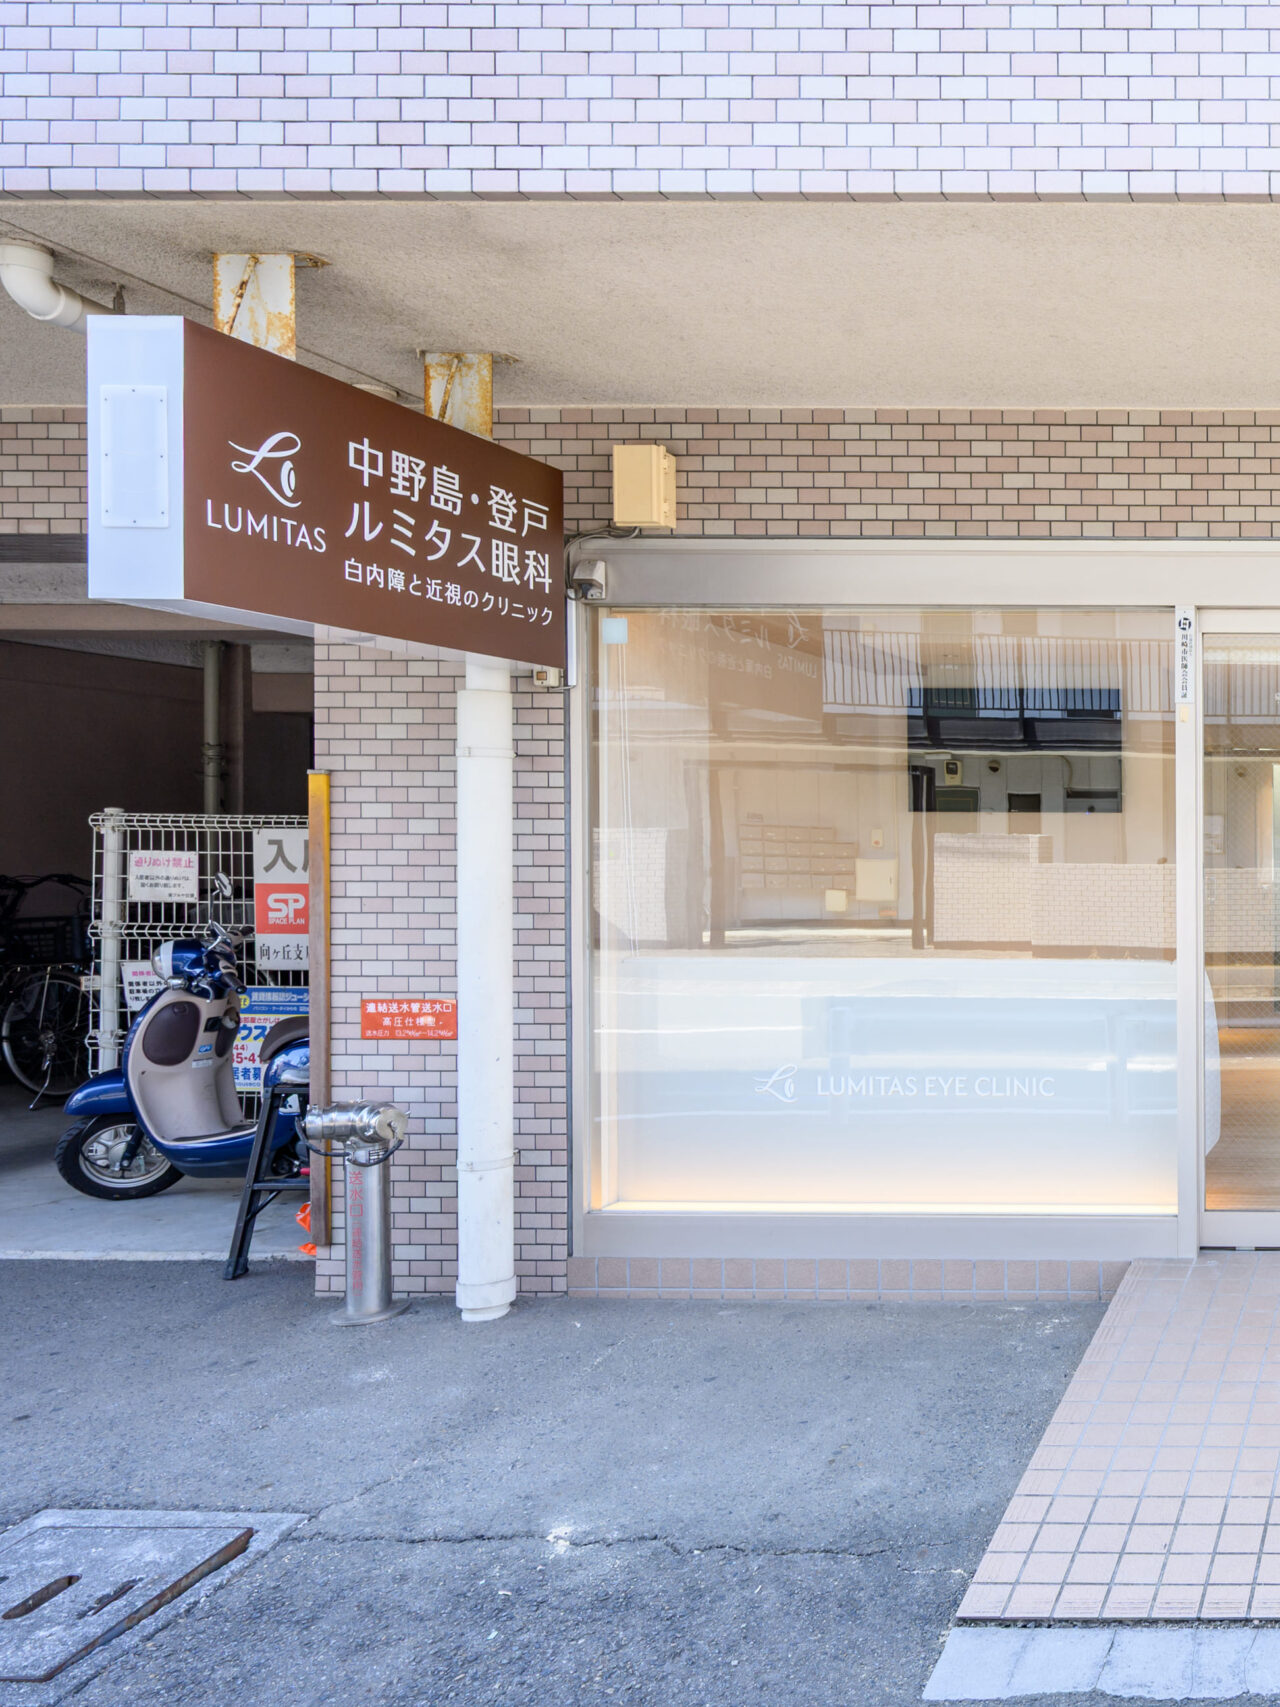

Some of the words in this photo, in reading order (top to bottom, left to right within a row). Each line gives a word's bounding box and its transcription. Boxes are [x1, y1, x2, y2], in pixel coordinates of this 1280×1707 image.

[348, 437, 550, 538] 中野島・登戸
[206, 498, 327, 553] LUMITAS
[344, 500, 553, 594] ルミタス眼科
[344, 557, 553, 626] 白内障と近視のクリニック
[134, 856, 194, 868] 通りぬけ禁止
[267, 893, 306, 920] SP
[260, 943, 309, 961] 向ヶ丘支
[366, 1002, 452, 1013] 連結送水管送水口
[815, 1075, 918, 1097] LUMITAS
[924, 1075, 969, 1097] EYE
[974, 1075, 1056, 1098] CLINIC
[348, 1170, 363, 1217] 送水口
